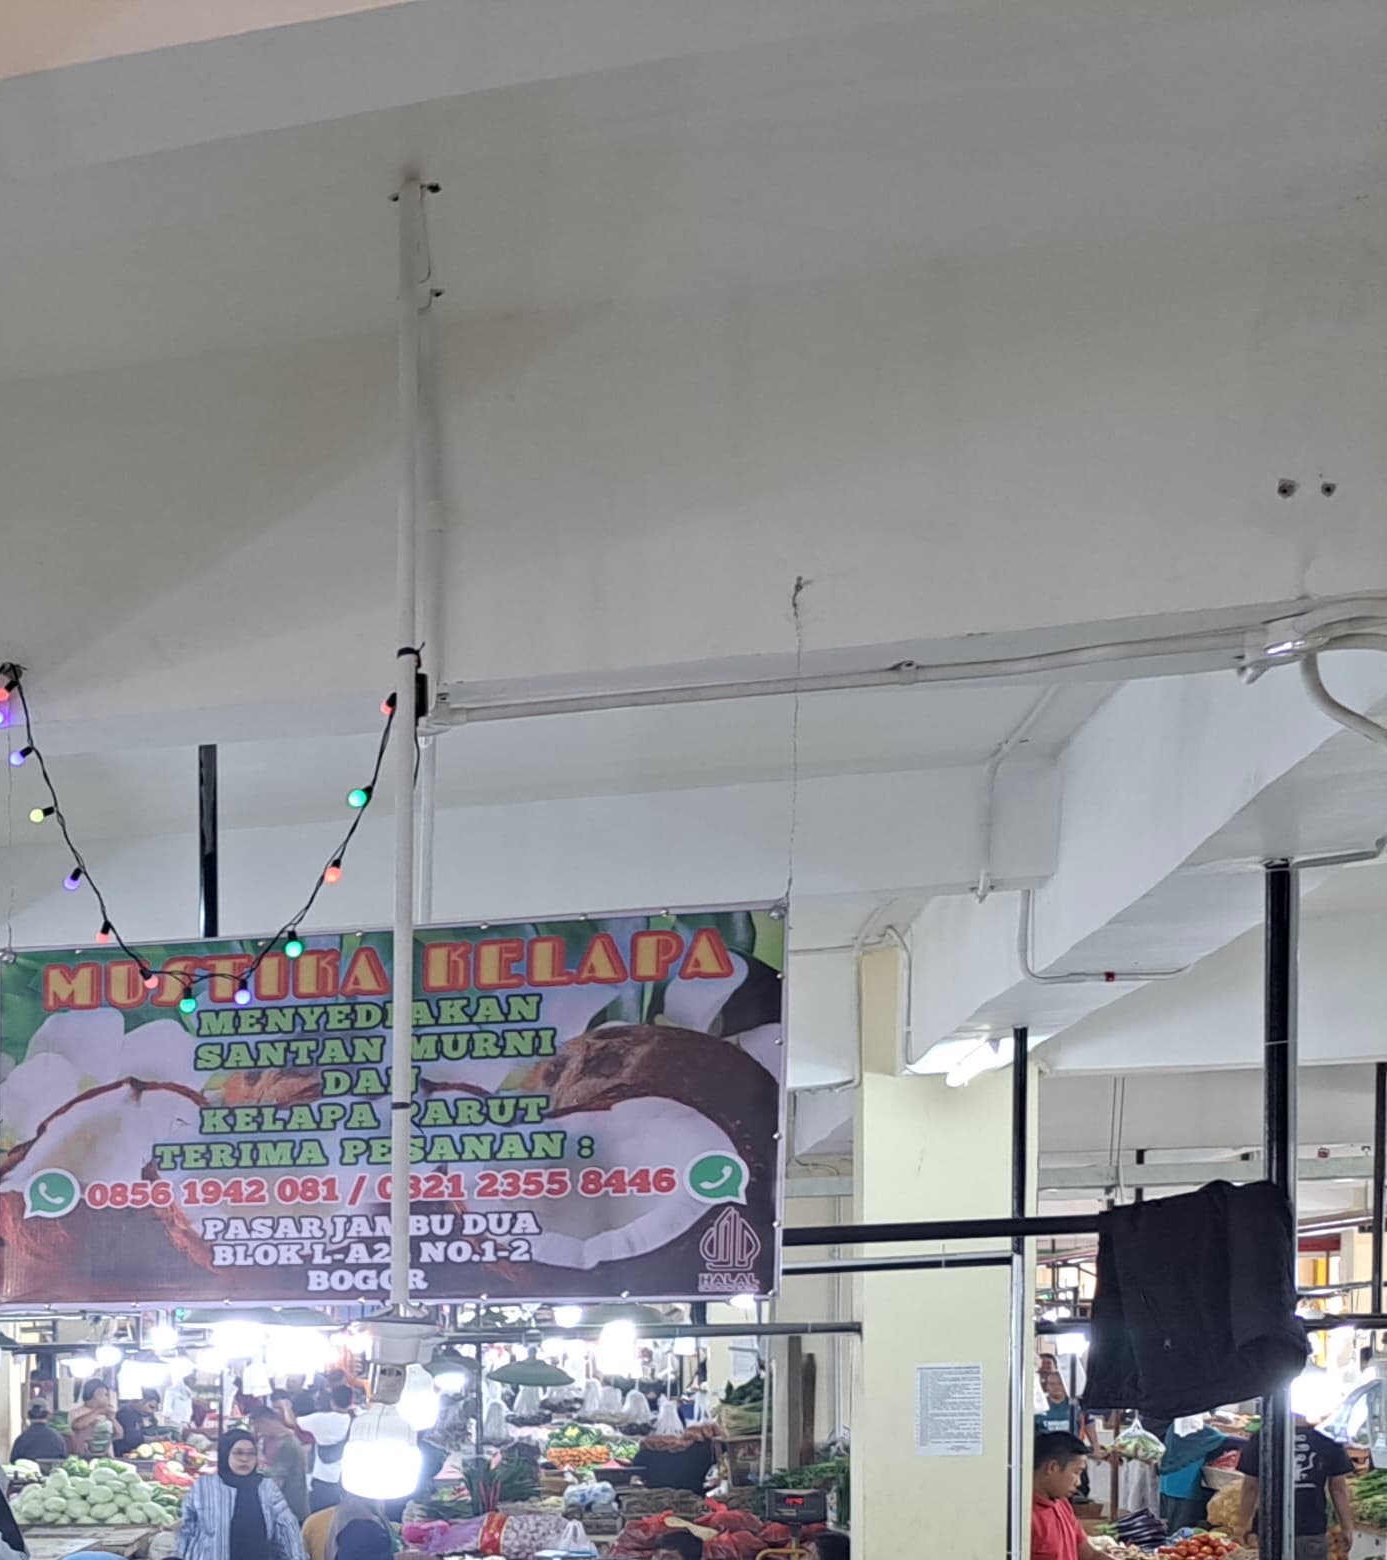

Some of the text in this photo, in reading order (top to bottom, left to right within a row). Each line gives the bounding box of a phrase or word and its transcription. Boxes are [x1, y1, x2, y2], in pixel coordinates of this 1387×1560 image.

[42, 928, 734, 1012] MUSTIKA KELAPA
[194, 1027, 557, 1070] SANTAN MURNI
[200, 1101, 380, 1135] KELAPA
[153, 1138, 329, 1171] TERIMA
[339, 1130, 567, 1166] PESANAN
[84, 1179, 174, 1209] 0856
[181, 1175, 269, 1206] 1942
[275, 1173, 340, 1205] 081
[346, 1173, 370, 1208] /
[476, 1167, 570, 1199] 2355
[578, 1165, 678, 1197] 8446
[202, 1215, 325, 1242] PASAR
[462, 1210, 542, 1237] DUA
[212, 1238, 533, 1268] BLOK L-A2 NO.1-2
[698, 1272, 760, 1286] HALAL
